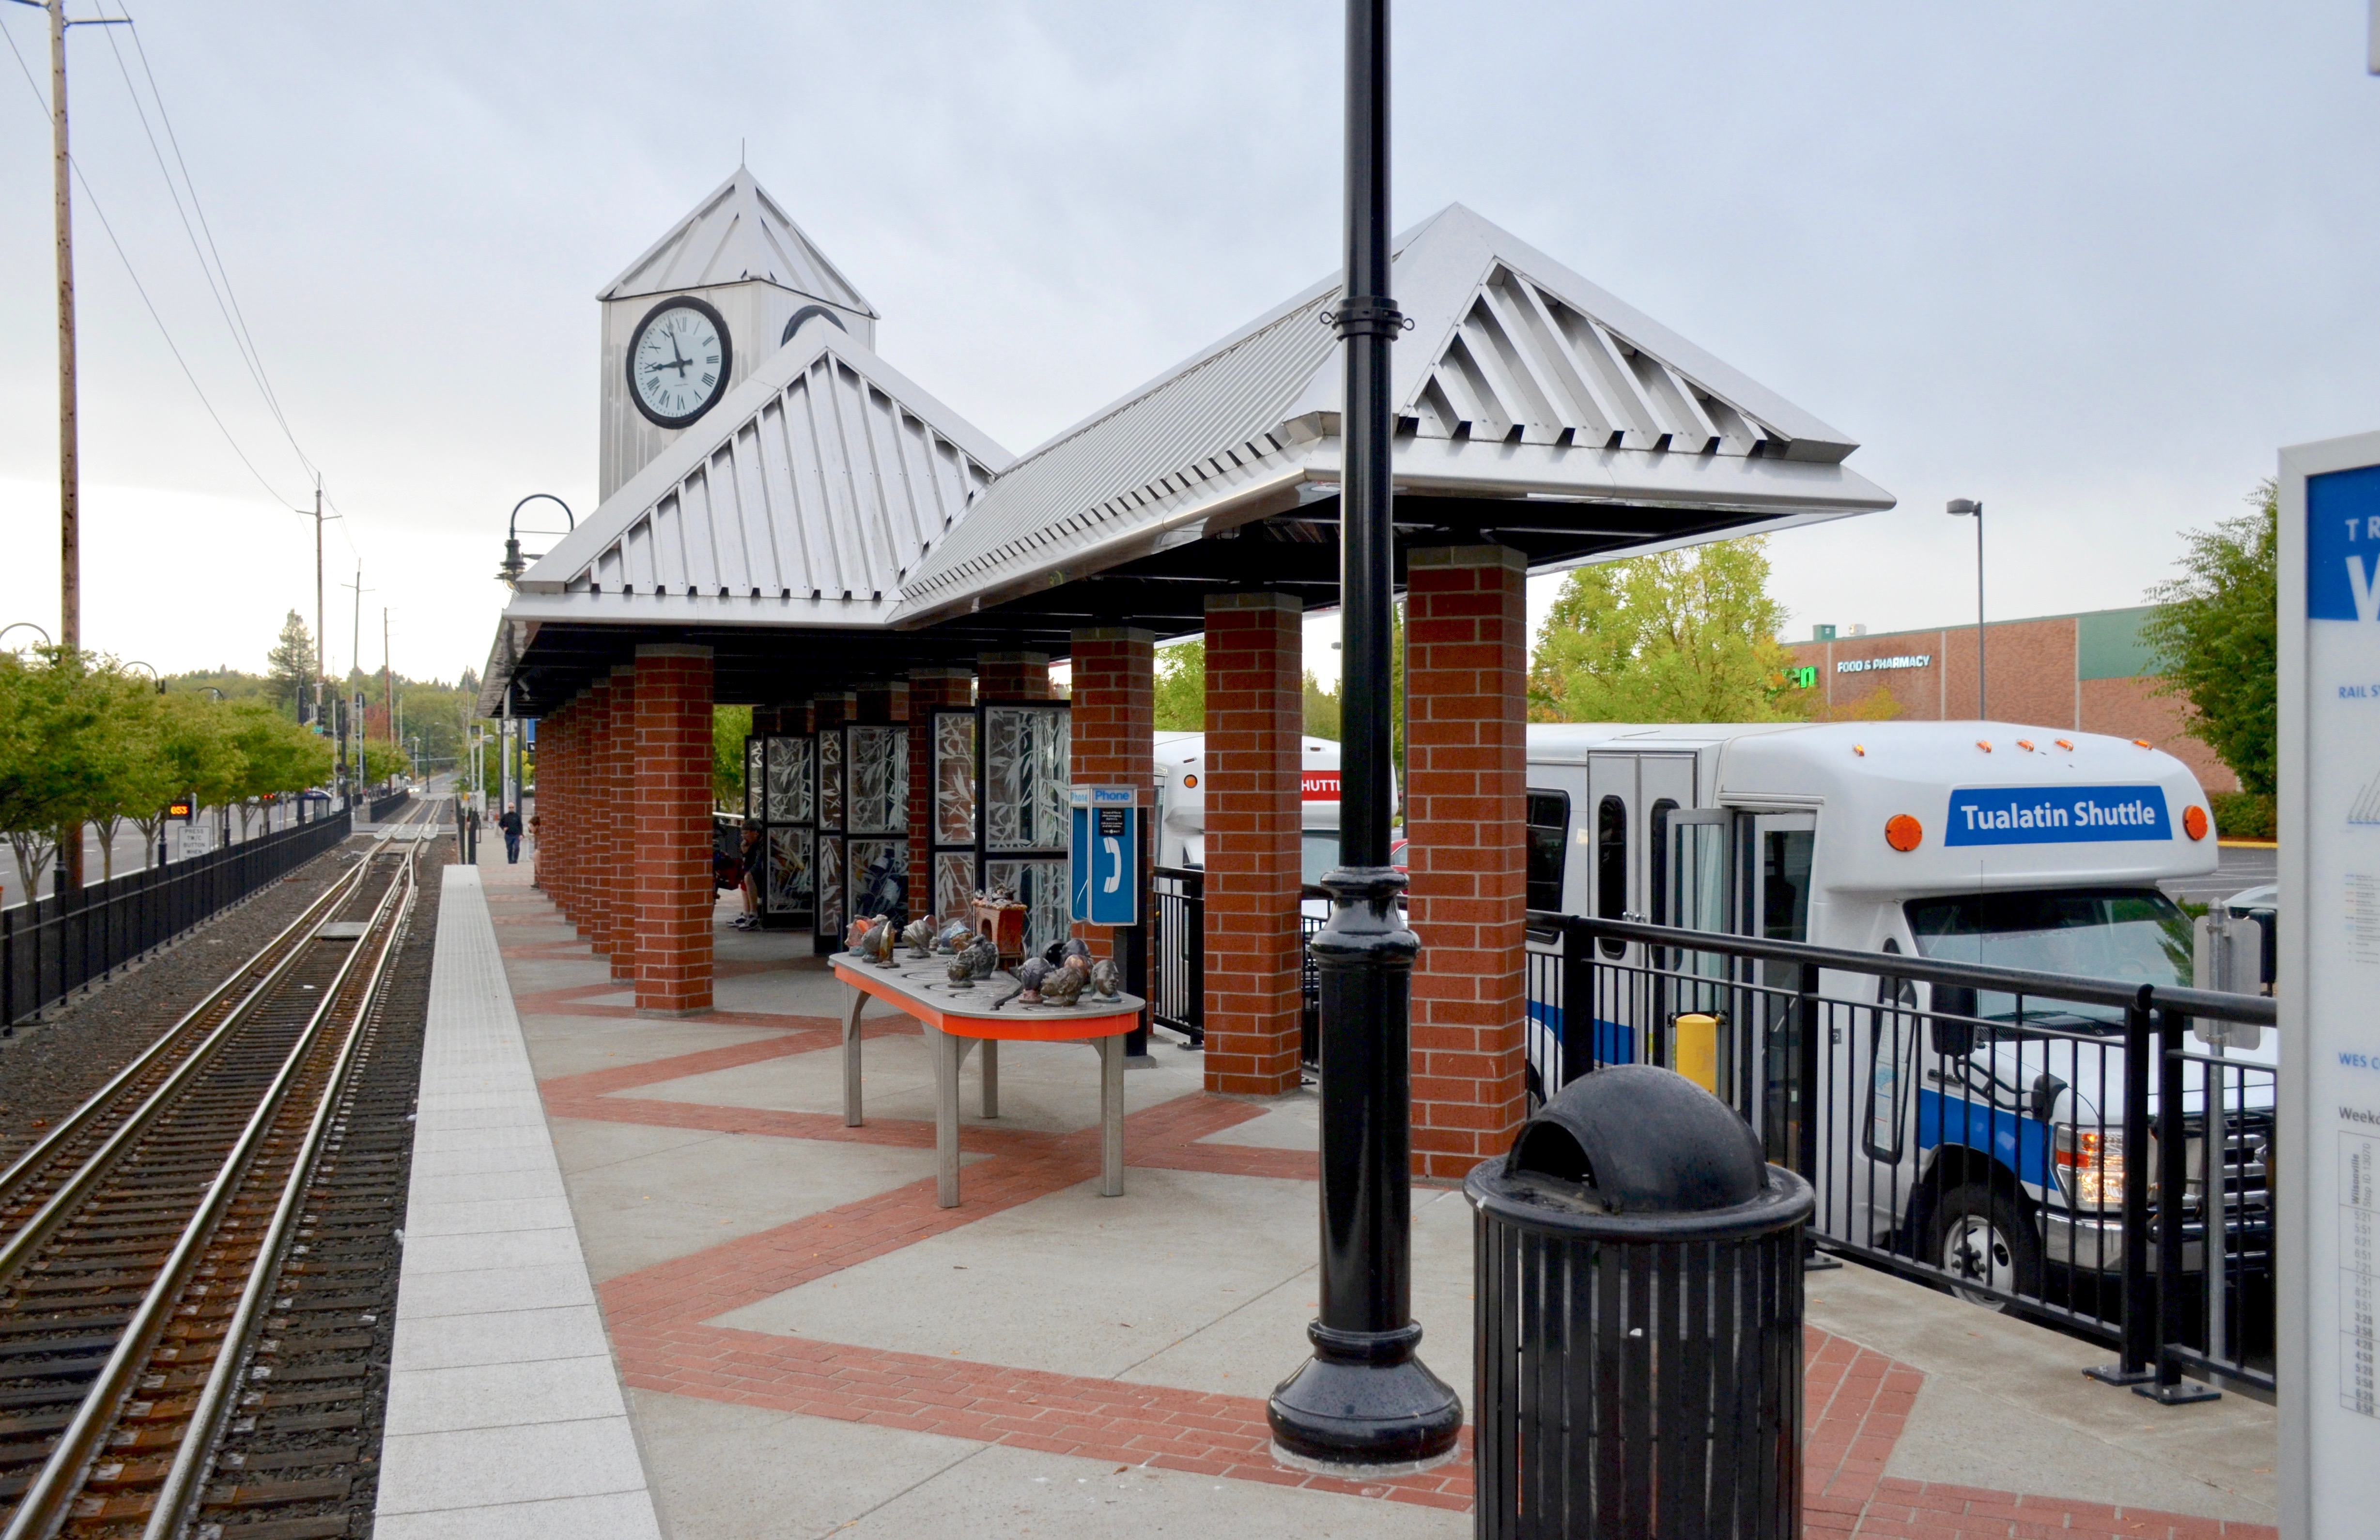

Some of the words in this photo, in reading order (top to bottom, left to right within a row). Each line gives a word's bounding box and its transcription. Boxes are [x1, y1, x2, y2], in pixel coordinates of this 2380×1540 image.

[1837, 661, 1863, 673] FOOD
[1864, 660, 1871, 670] &
[1873, 655, 1931, 669] PHARMACY
[2339, 686, 2367, 698] RAIL
[1070, 792, 1088, 802] Phone
[1096, 790, 1129, 800] Phone
[1961, 802, 2068, 830] Tualatin
[2074, 800, 2155, 826] Shuttle
[2339, 1052, 2367, 1067] WES
[2351, 1154, 2360, 1204] Wilsonville
[2363, 1187, 2372, 1207] Stop
